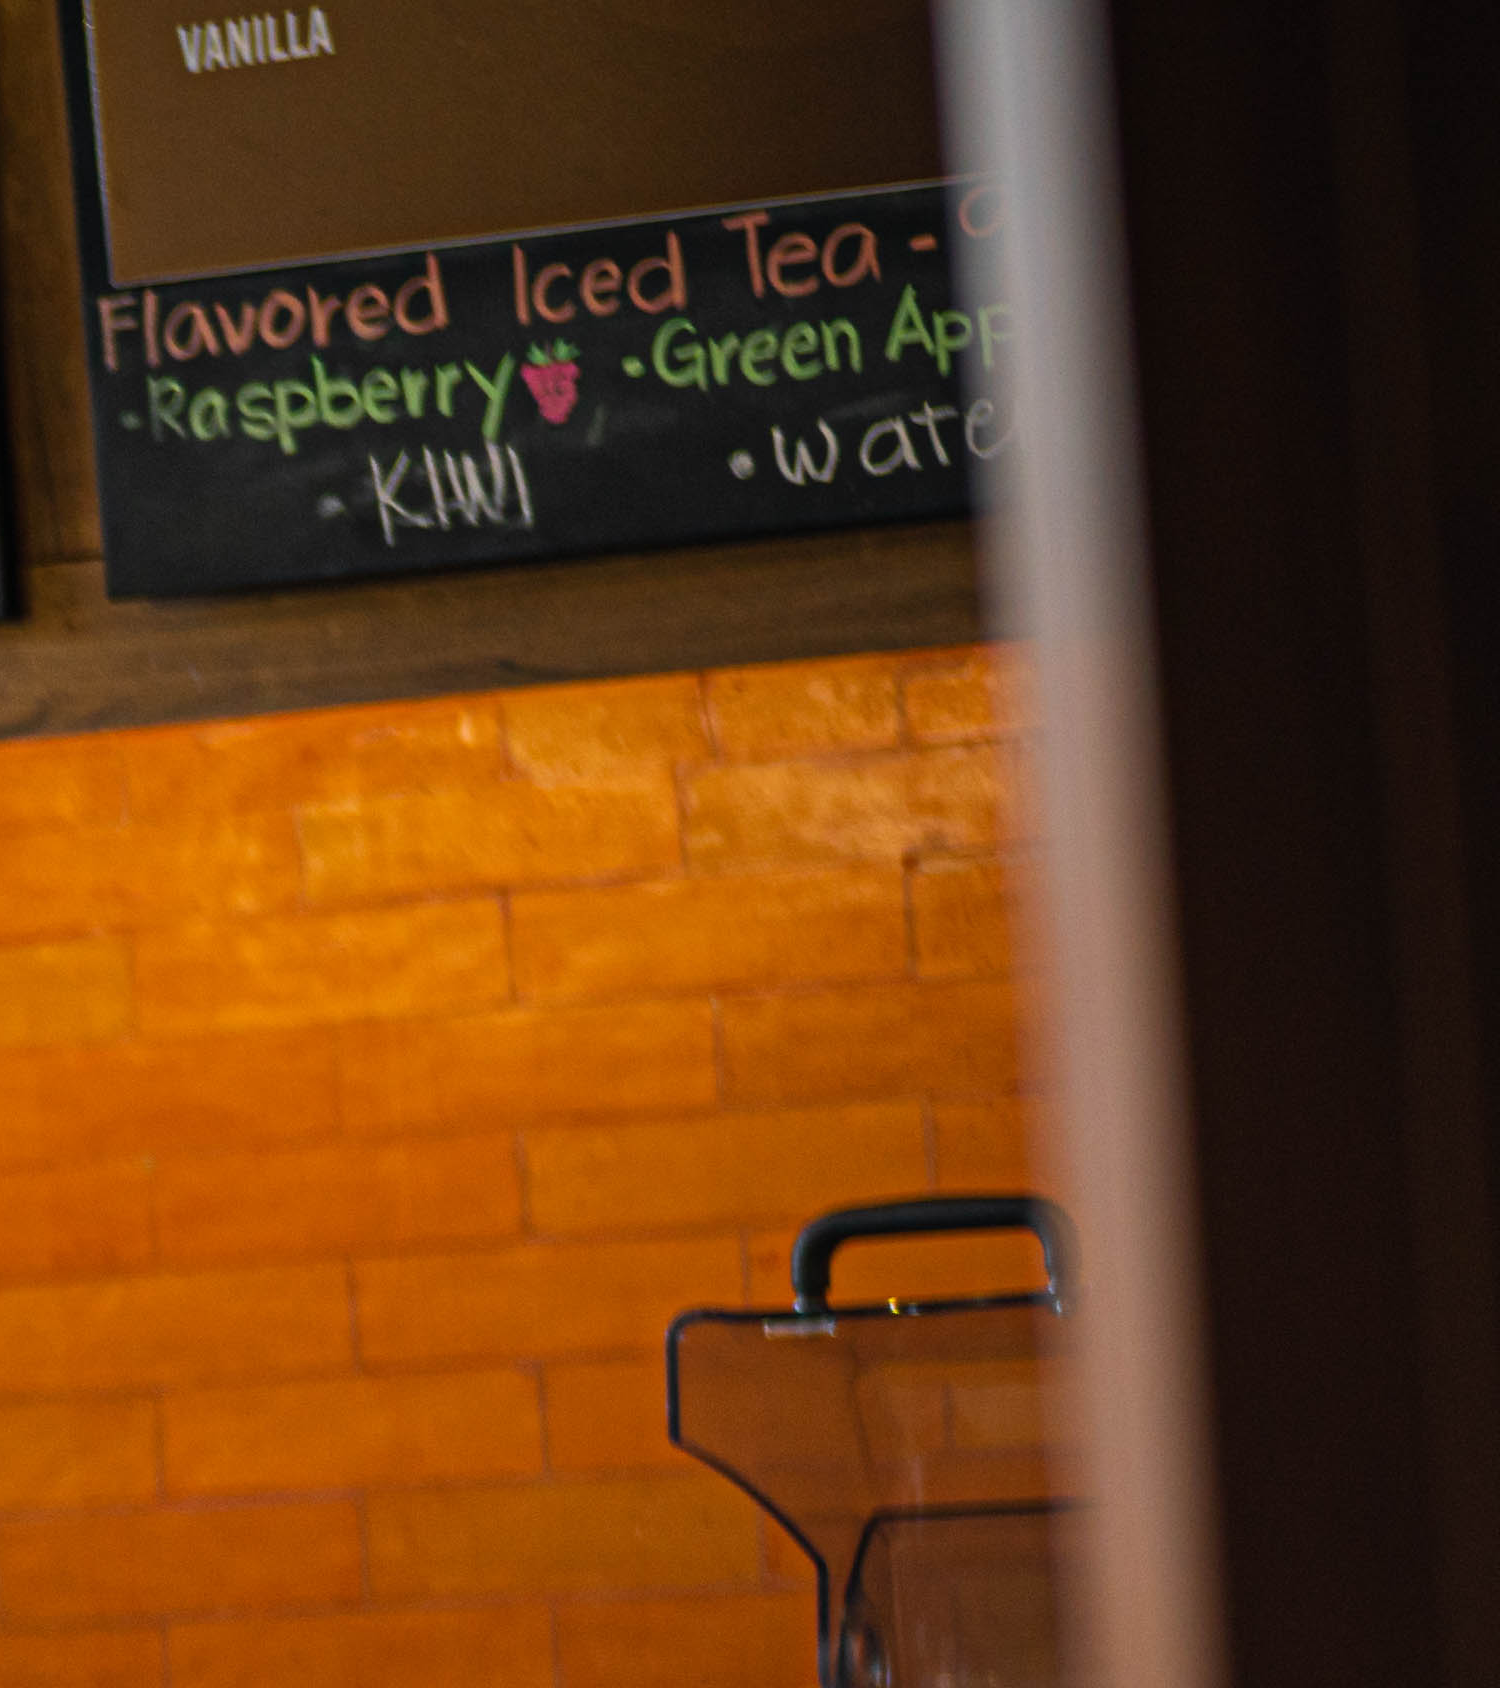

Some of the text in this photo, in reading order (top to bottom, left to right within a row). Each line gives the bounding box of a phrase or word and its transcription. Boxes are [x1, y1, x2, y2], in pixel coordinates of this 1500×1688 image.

[176, 10, 336, 75] VANILLA
[99, 252, 451, 371] Flavored
[512, 230, 688, 326] Iced
[722, 211, 884, 303] Tea
[148, 350, 516, 455] Raspberry
[650, 318, 861, 391] Green
[368, 446, 534, 546] KIWI
